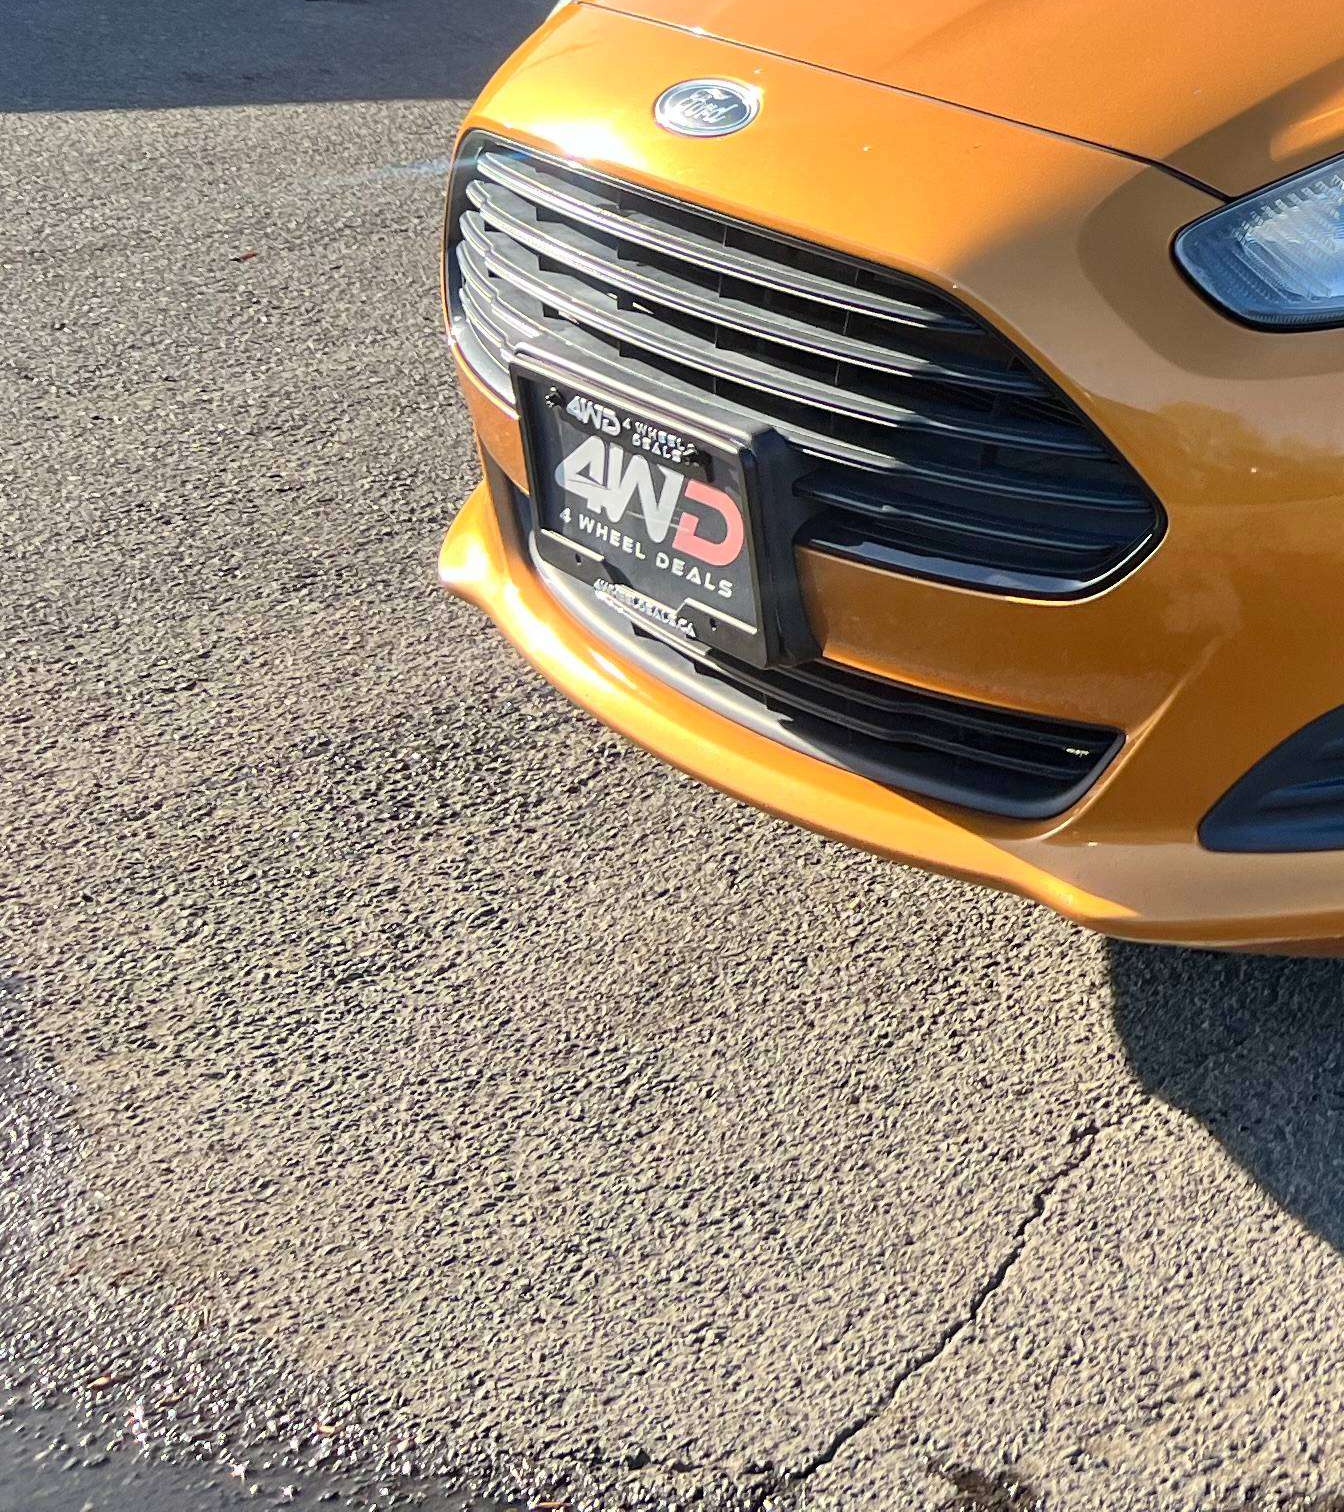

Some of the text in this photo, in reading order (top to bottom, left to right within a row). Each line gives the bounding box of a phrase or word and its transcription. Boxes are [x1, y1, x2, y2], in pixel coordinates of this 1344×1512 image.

[566, 395, 620, 436] 4WD
[554, 435, 744, 566] 4WD
[559, 507, 733, 599] 4 WHEEL DEALS
